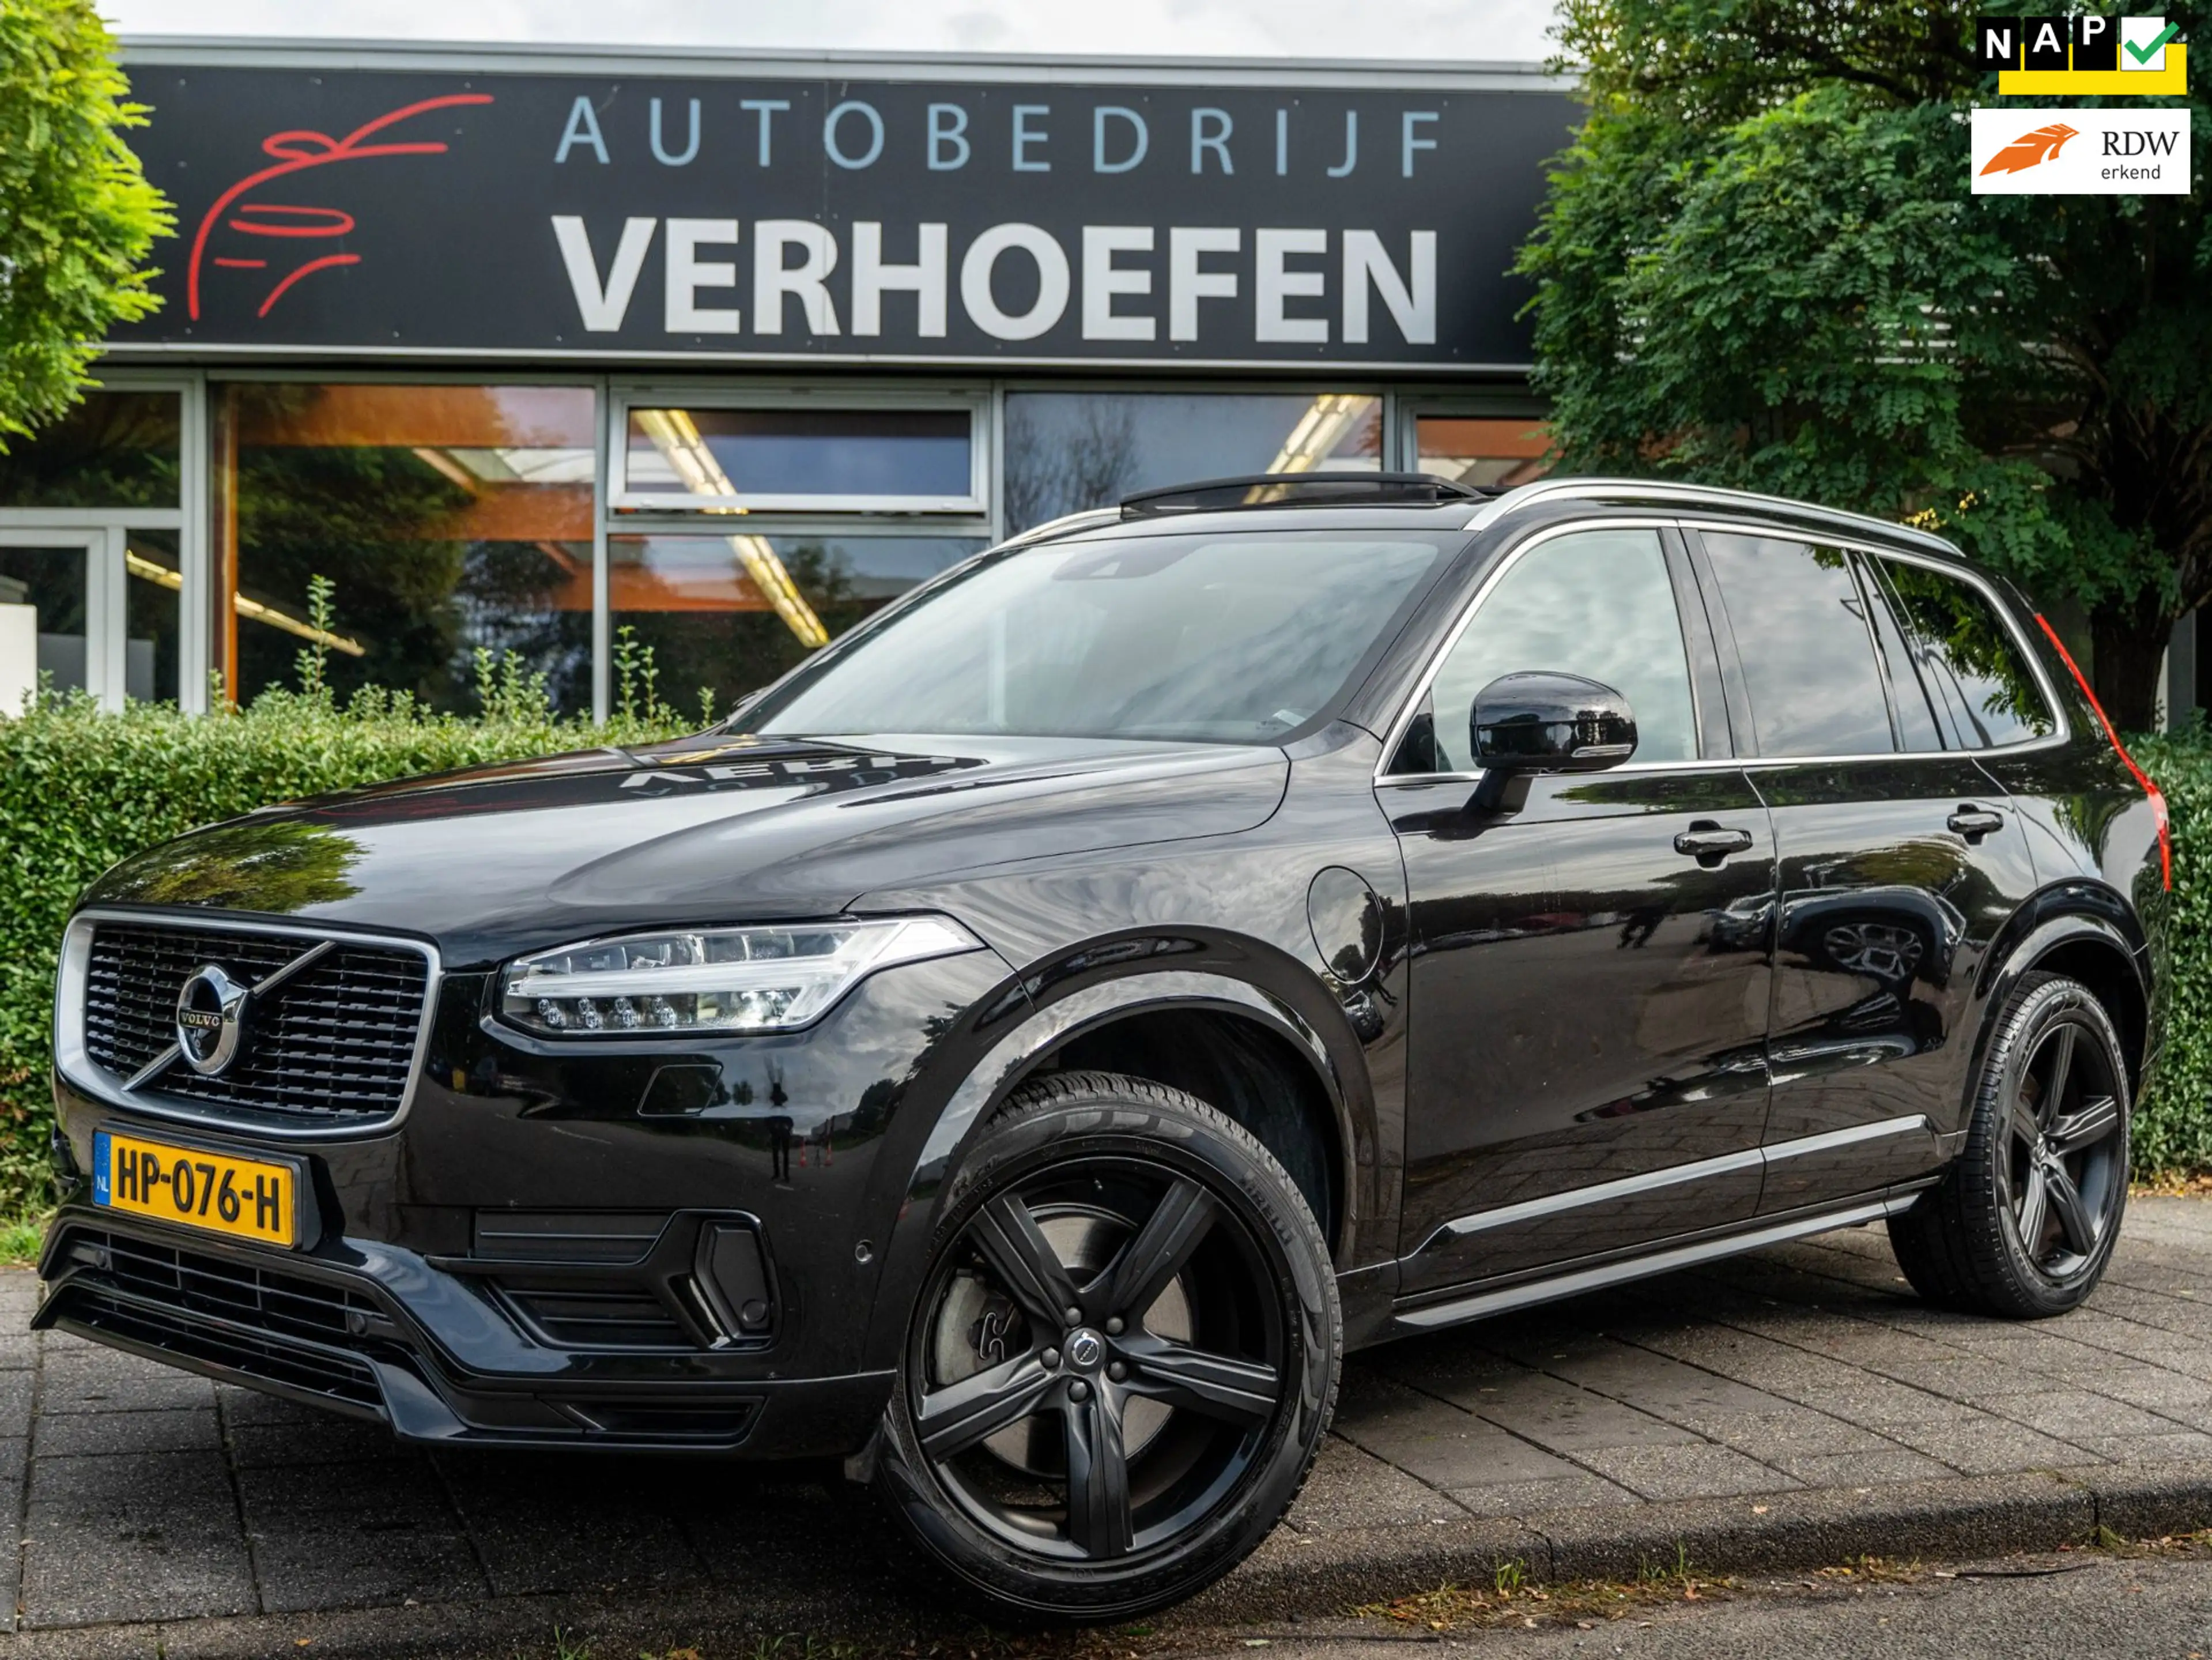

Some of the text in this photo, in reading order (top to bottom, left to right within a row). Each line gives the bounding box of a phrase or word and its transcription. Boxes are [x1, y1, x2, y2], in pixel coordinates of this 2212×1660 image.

[554, 95, 1440, 179] AUTOBEDRIJF
[550, 215, 1437, 346] VERHOEFEN
[181, 1012, 220, 1027] VOLVO
[97, 1175, 109, 1193] NL
[117, 1147, 280, 1233] HP-076-H
